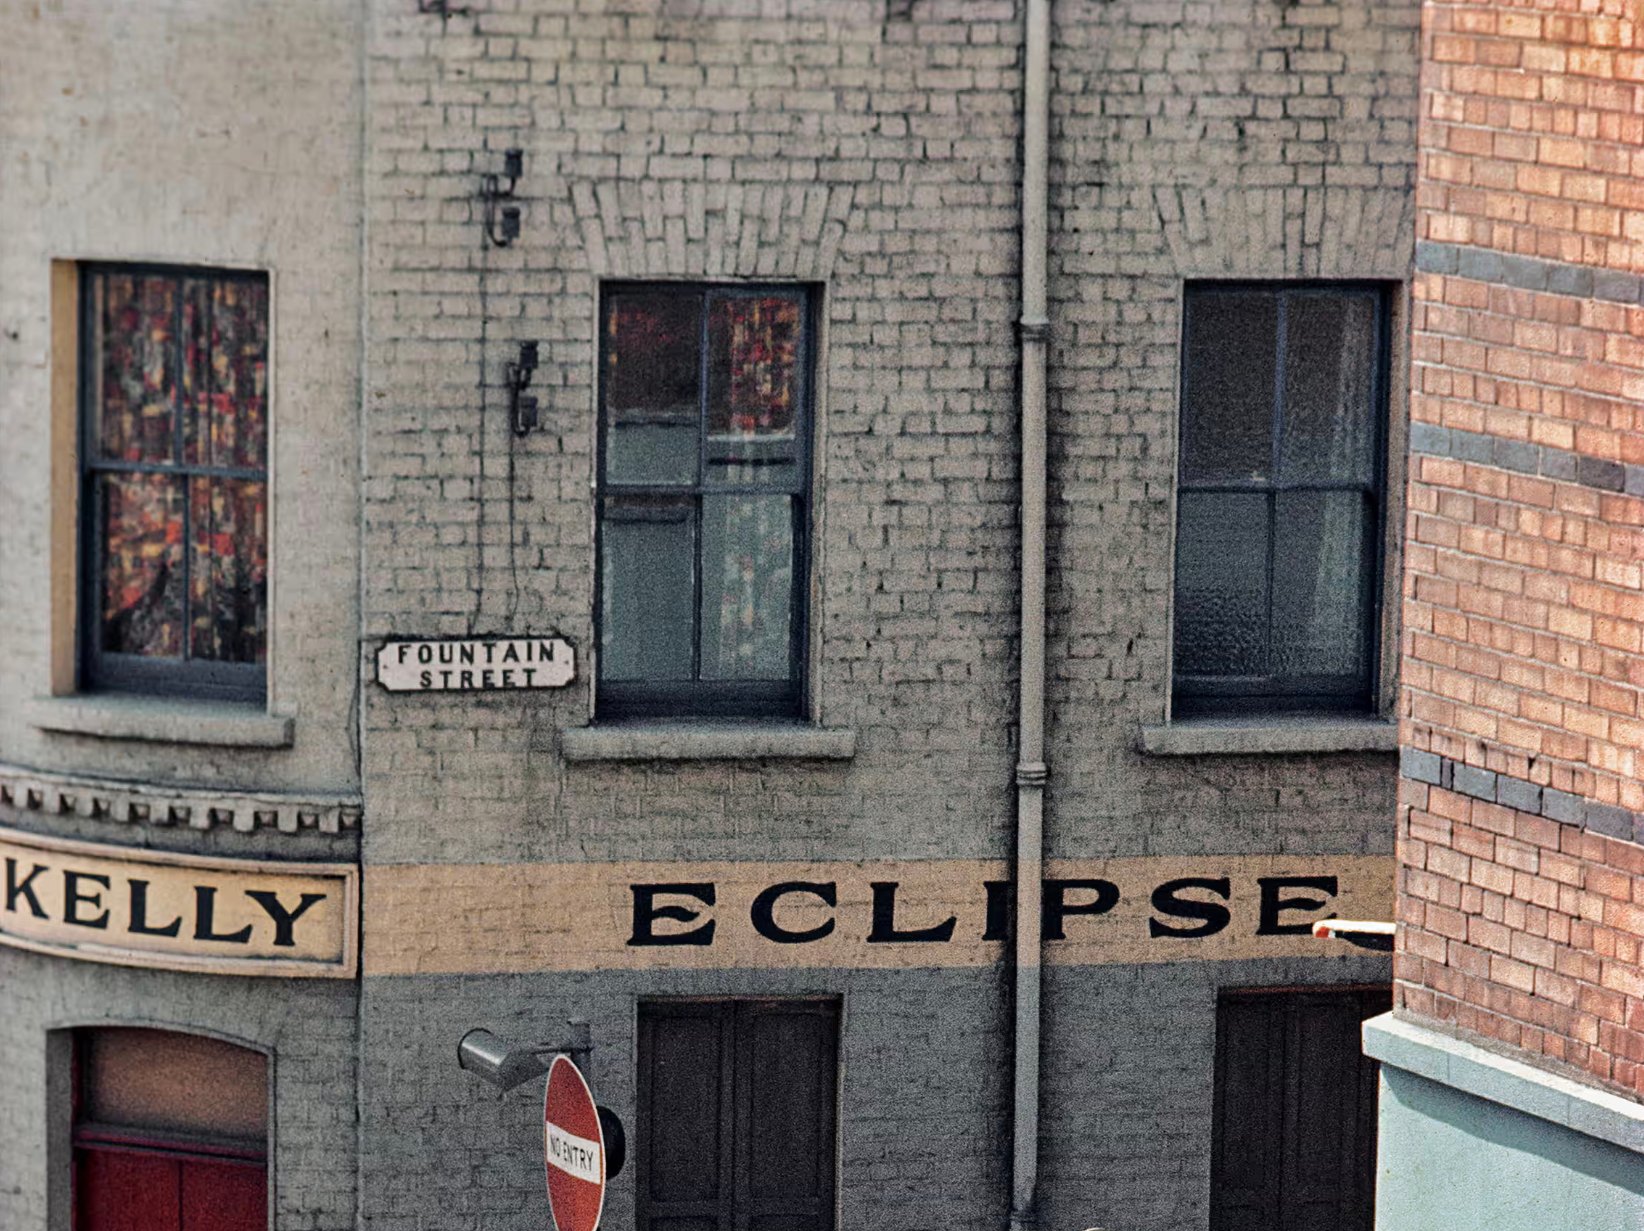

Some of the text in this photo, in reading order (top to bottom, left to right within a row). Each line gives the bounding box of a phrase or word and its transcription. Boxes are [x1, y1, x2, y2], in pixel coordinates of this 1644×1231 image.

[397, 641, 555, 664] FOUNTAIN
[420, 668, 537, 688] STREET
[5, 856, 328, 947] KELLY
[625, 875, 1339, 946] ECLIPSE
[549, 1134, 594, 1172] NO ENTRY
